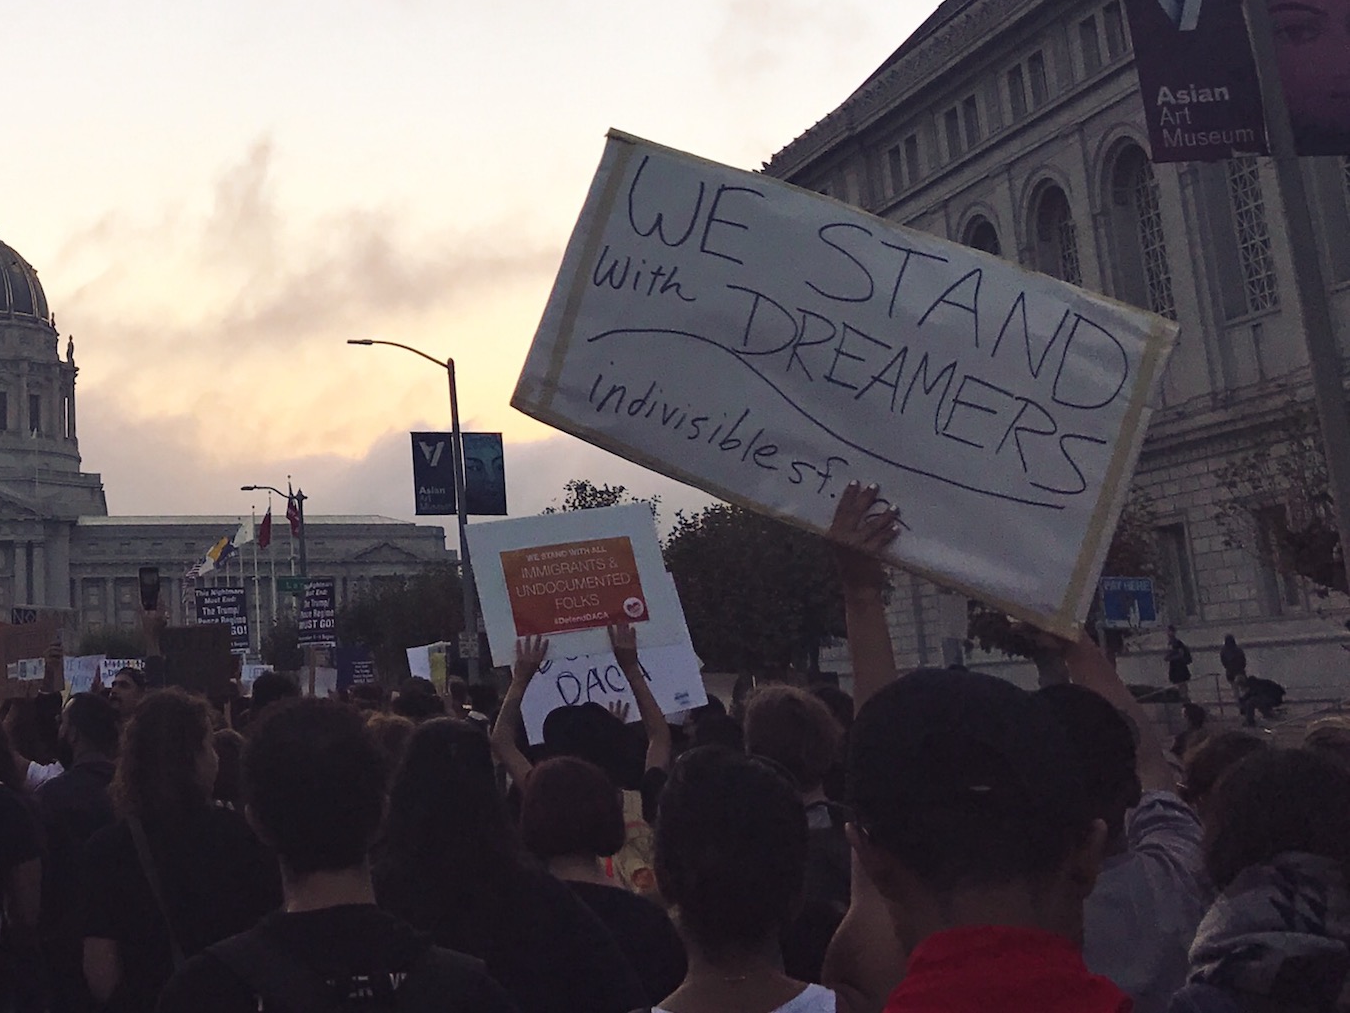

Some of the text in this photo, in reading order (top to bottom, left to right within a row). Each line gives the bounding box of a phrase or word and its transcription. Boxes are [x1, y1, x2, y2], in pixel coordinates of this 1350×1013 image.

[1156, 83, 1230, 106] Asian
[1160, 106, 1192, 126] Art
[1162, 127, 1255, 148] Museum
[628, 155, 1128, 409] WE STAND
[726, 283, 1107, 495] DREAMERS
[419, 486, 446, 495] Asian
[525, 545, 607, 562] WE STAND WITH ALL
[521, 556, 619, 579] IMMIGRANTS &
[515, 571, 631, 598] UNDOCUMENTED
[201, 606, 216, 616] The
[555, 594, 600, 610] FOLKS
[12, 608, 37, 625] NO
[319, 618, 335, 629] GO!
